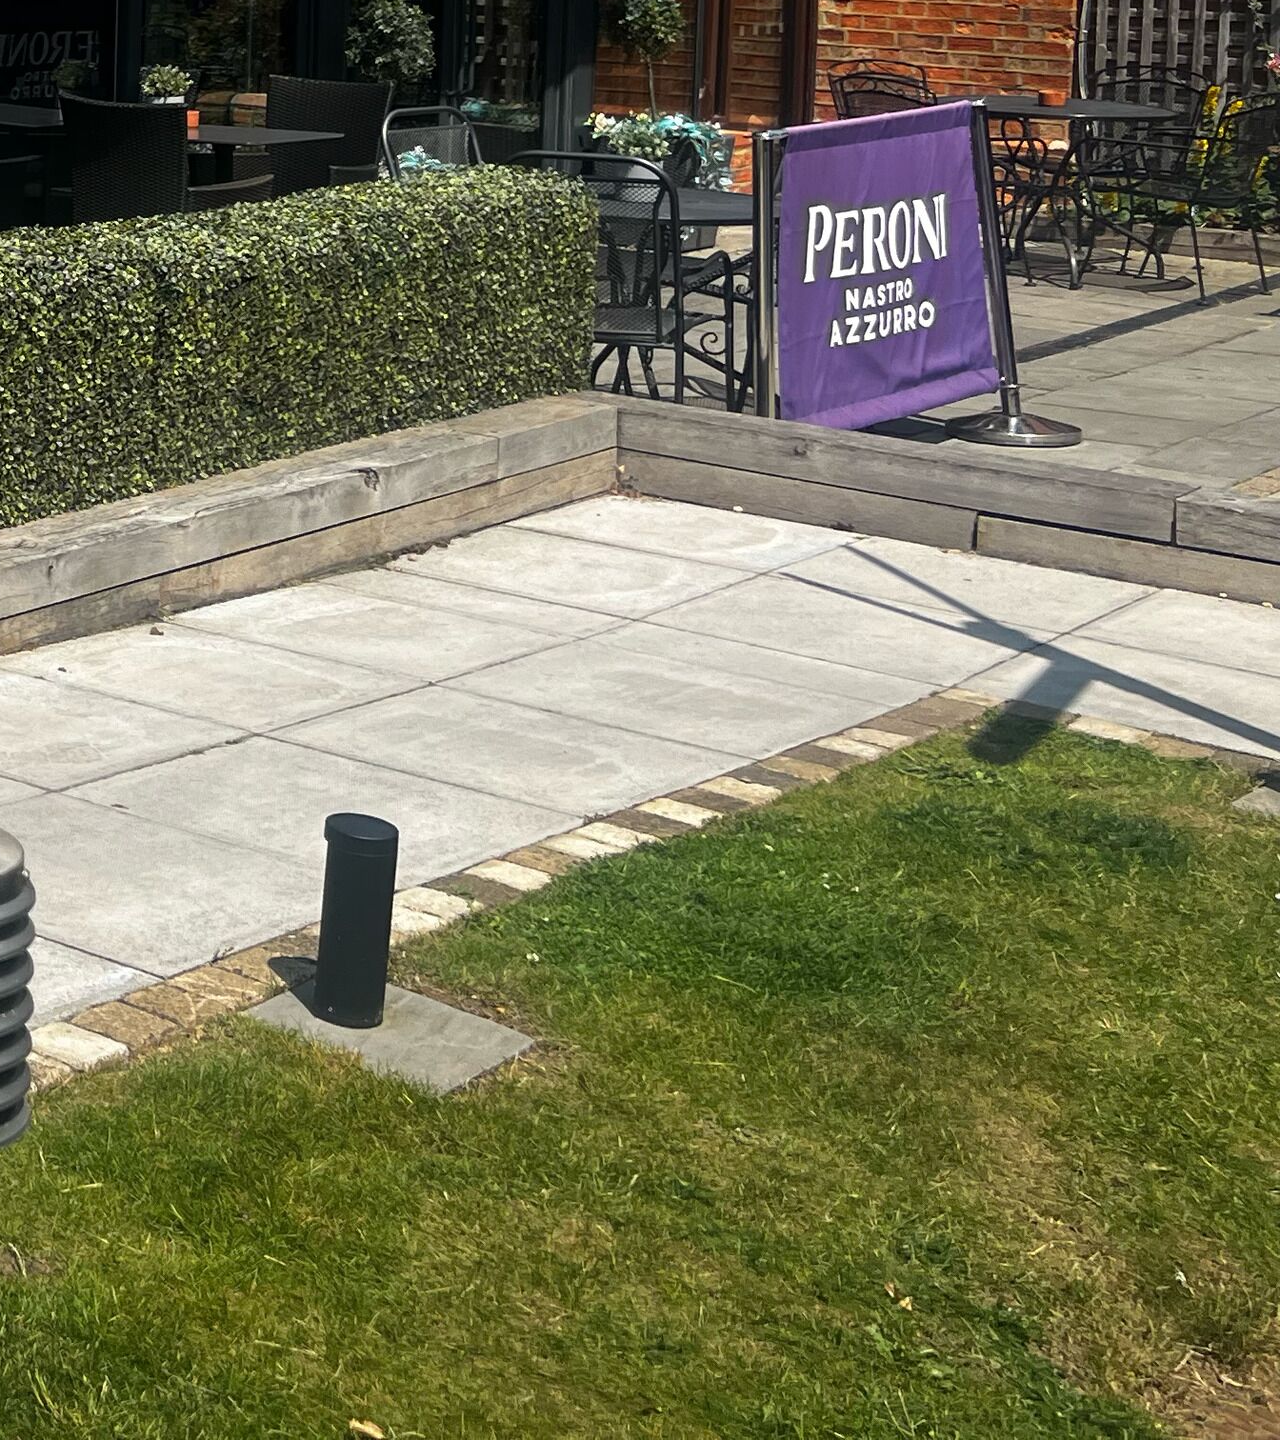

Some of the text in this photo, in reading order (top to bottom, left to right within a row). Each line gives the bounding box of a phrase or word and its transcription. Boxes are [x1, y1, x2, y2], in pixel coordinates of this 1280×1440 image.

[803, 193, 947, 283] PERONI
[844, 277, 913, 311] NASTRO
[829, 301, 936, 348] AZZURRO
